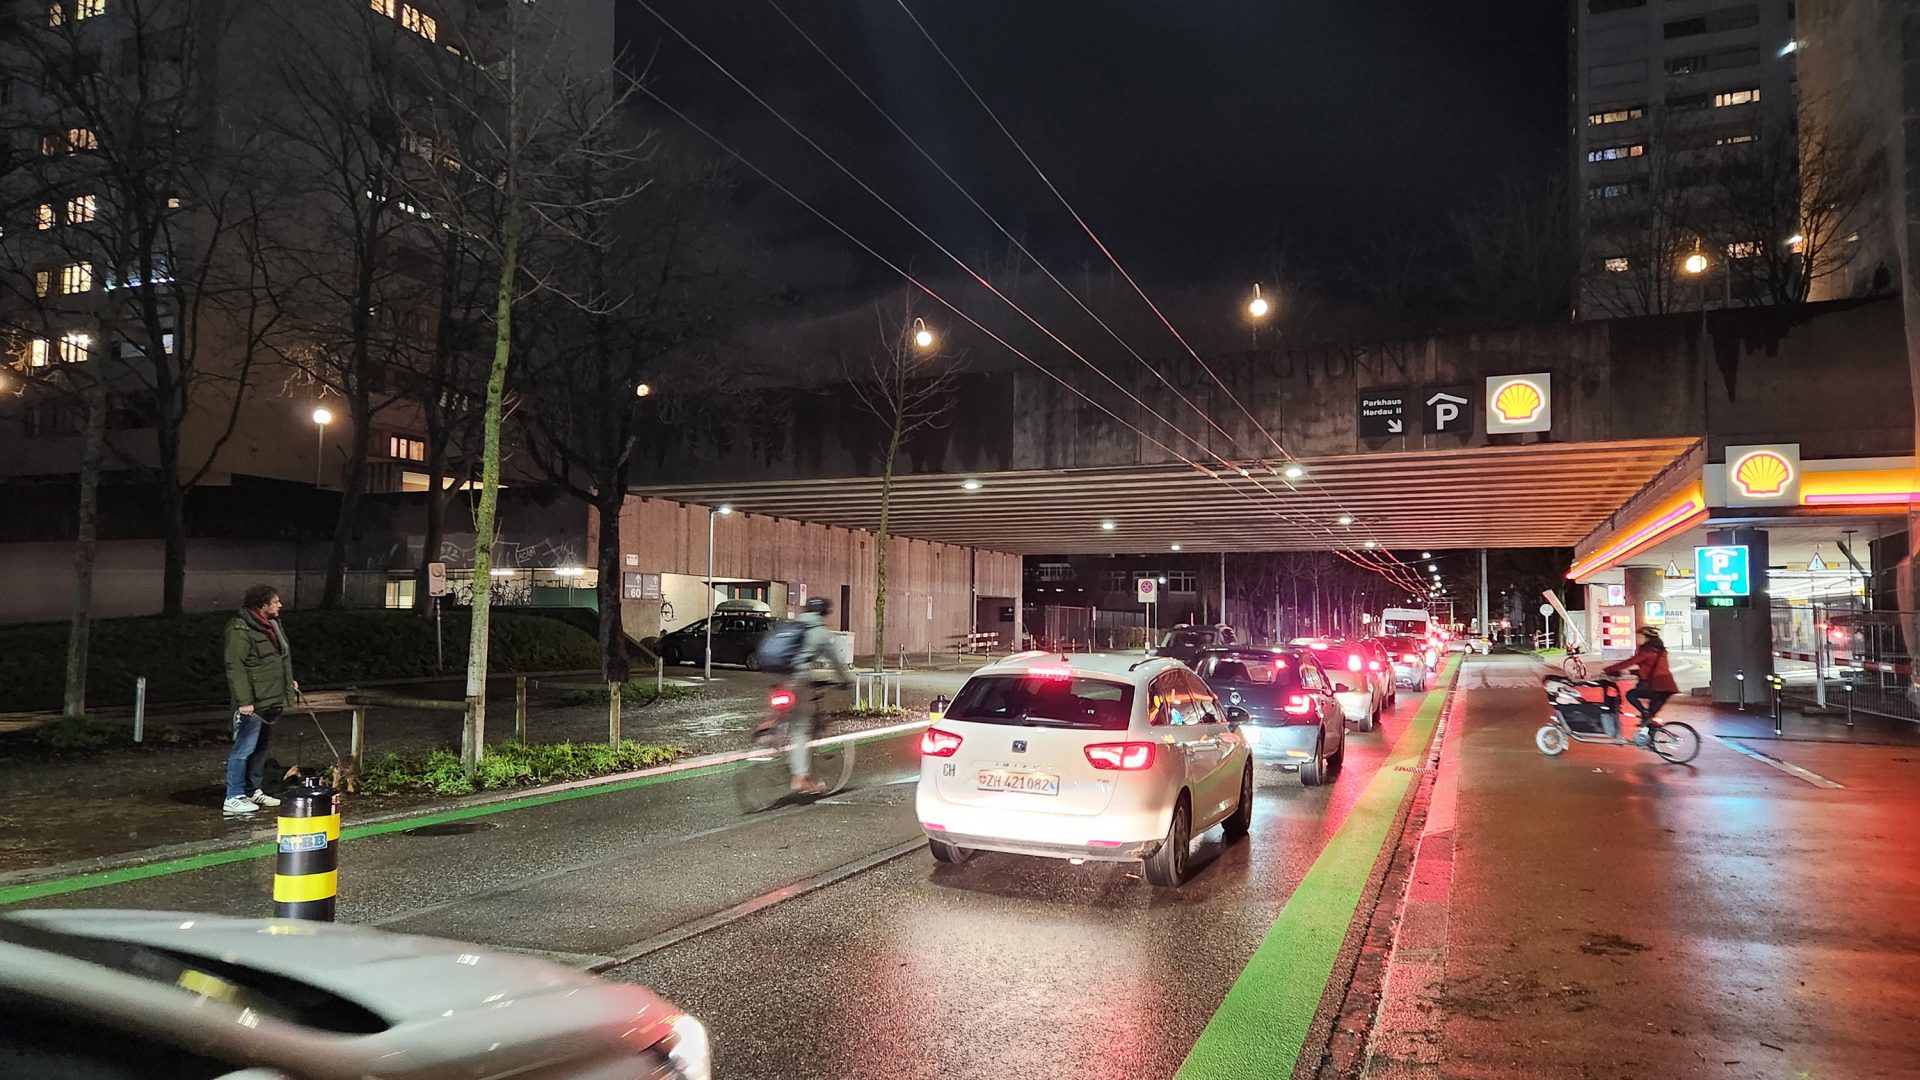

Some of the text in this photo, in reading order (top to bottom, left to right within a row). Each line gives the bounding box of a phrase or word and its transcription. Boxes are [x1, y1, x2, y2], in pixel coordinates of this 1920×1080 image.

[1363, 399, 1402, 407] Parkhaus
[1363, 408, 1393, 416] Hardau
[1436, 403, 1459, 430] P
[1711, 554, 1729, 575] P
[630, 588, 641, 598] 60
[943, 764, 956, 777] CH
[986, 774, 1050, 791] ZH 421082
